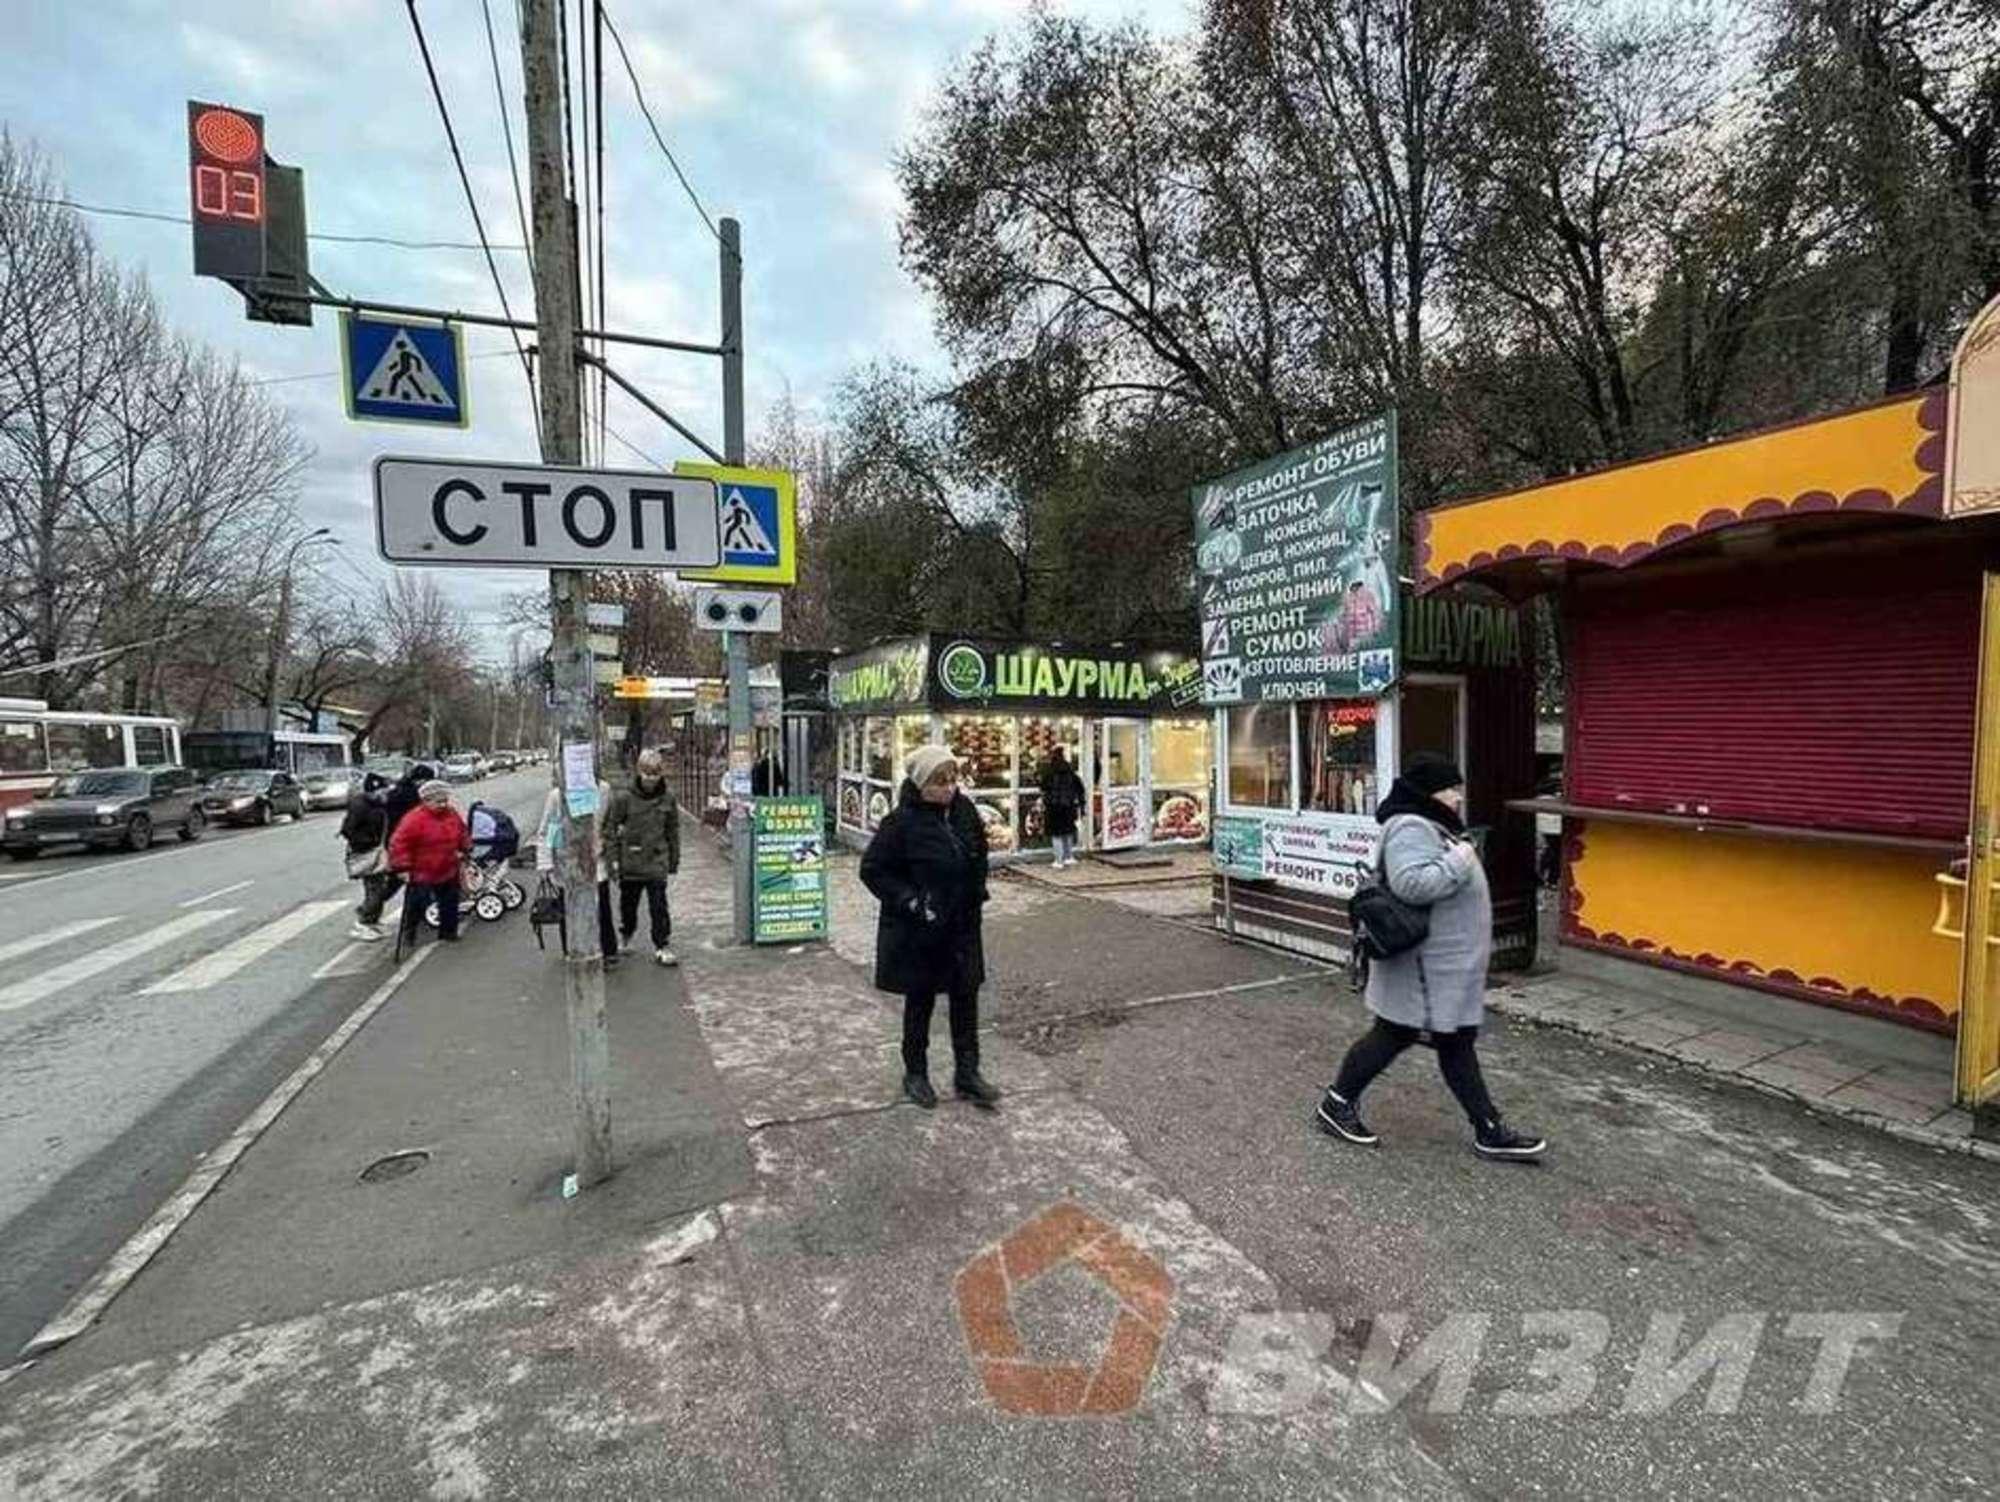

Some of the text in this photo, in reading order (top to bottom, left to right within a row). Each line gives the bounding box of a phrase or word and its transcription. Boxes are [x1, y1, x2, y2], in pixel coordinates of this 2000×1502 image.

[197, 164, 260, 221] 03
[1235, 462, 1311, 501] РЕМОНТ
[1313, 433, 1387, 474] ОБУВИ
[432, 478, 676, 551] СТОП
[1236, 491, 1319, 532] ЗАТОЧКА
[1207, 571, 1343, 618] ЗАМЕНА МОЛНИЙ
[1231, 606, 1308, 637] РЕМОНТ
[1246, 628, 1324, 656] СУМОК
[1405, 596, 1521, 667] ШАУРМА
[996, 655, 1149, 700] ШАУРМА
[1240, 653, 1358, 678] ИЗГОТОВЛЕНИЕ
[1261, 677, 1327, 700] КЛЮЧЕЙ
[1264, 860, 1327, 883] РЕМОНТ
